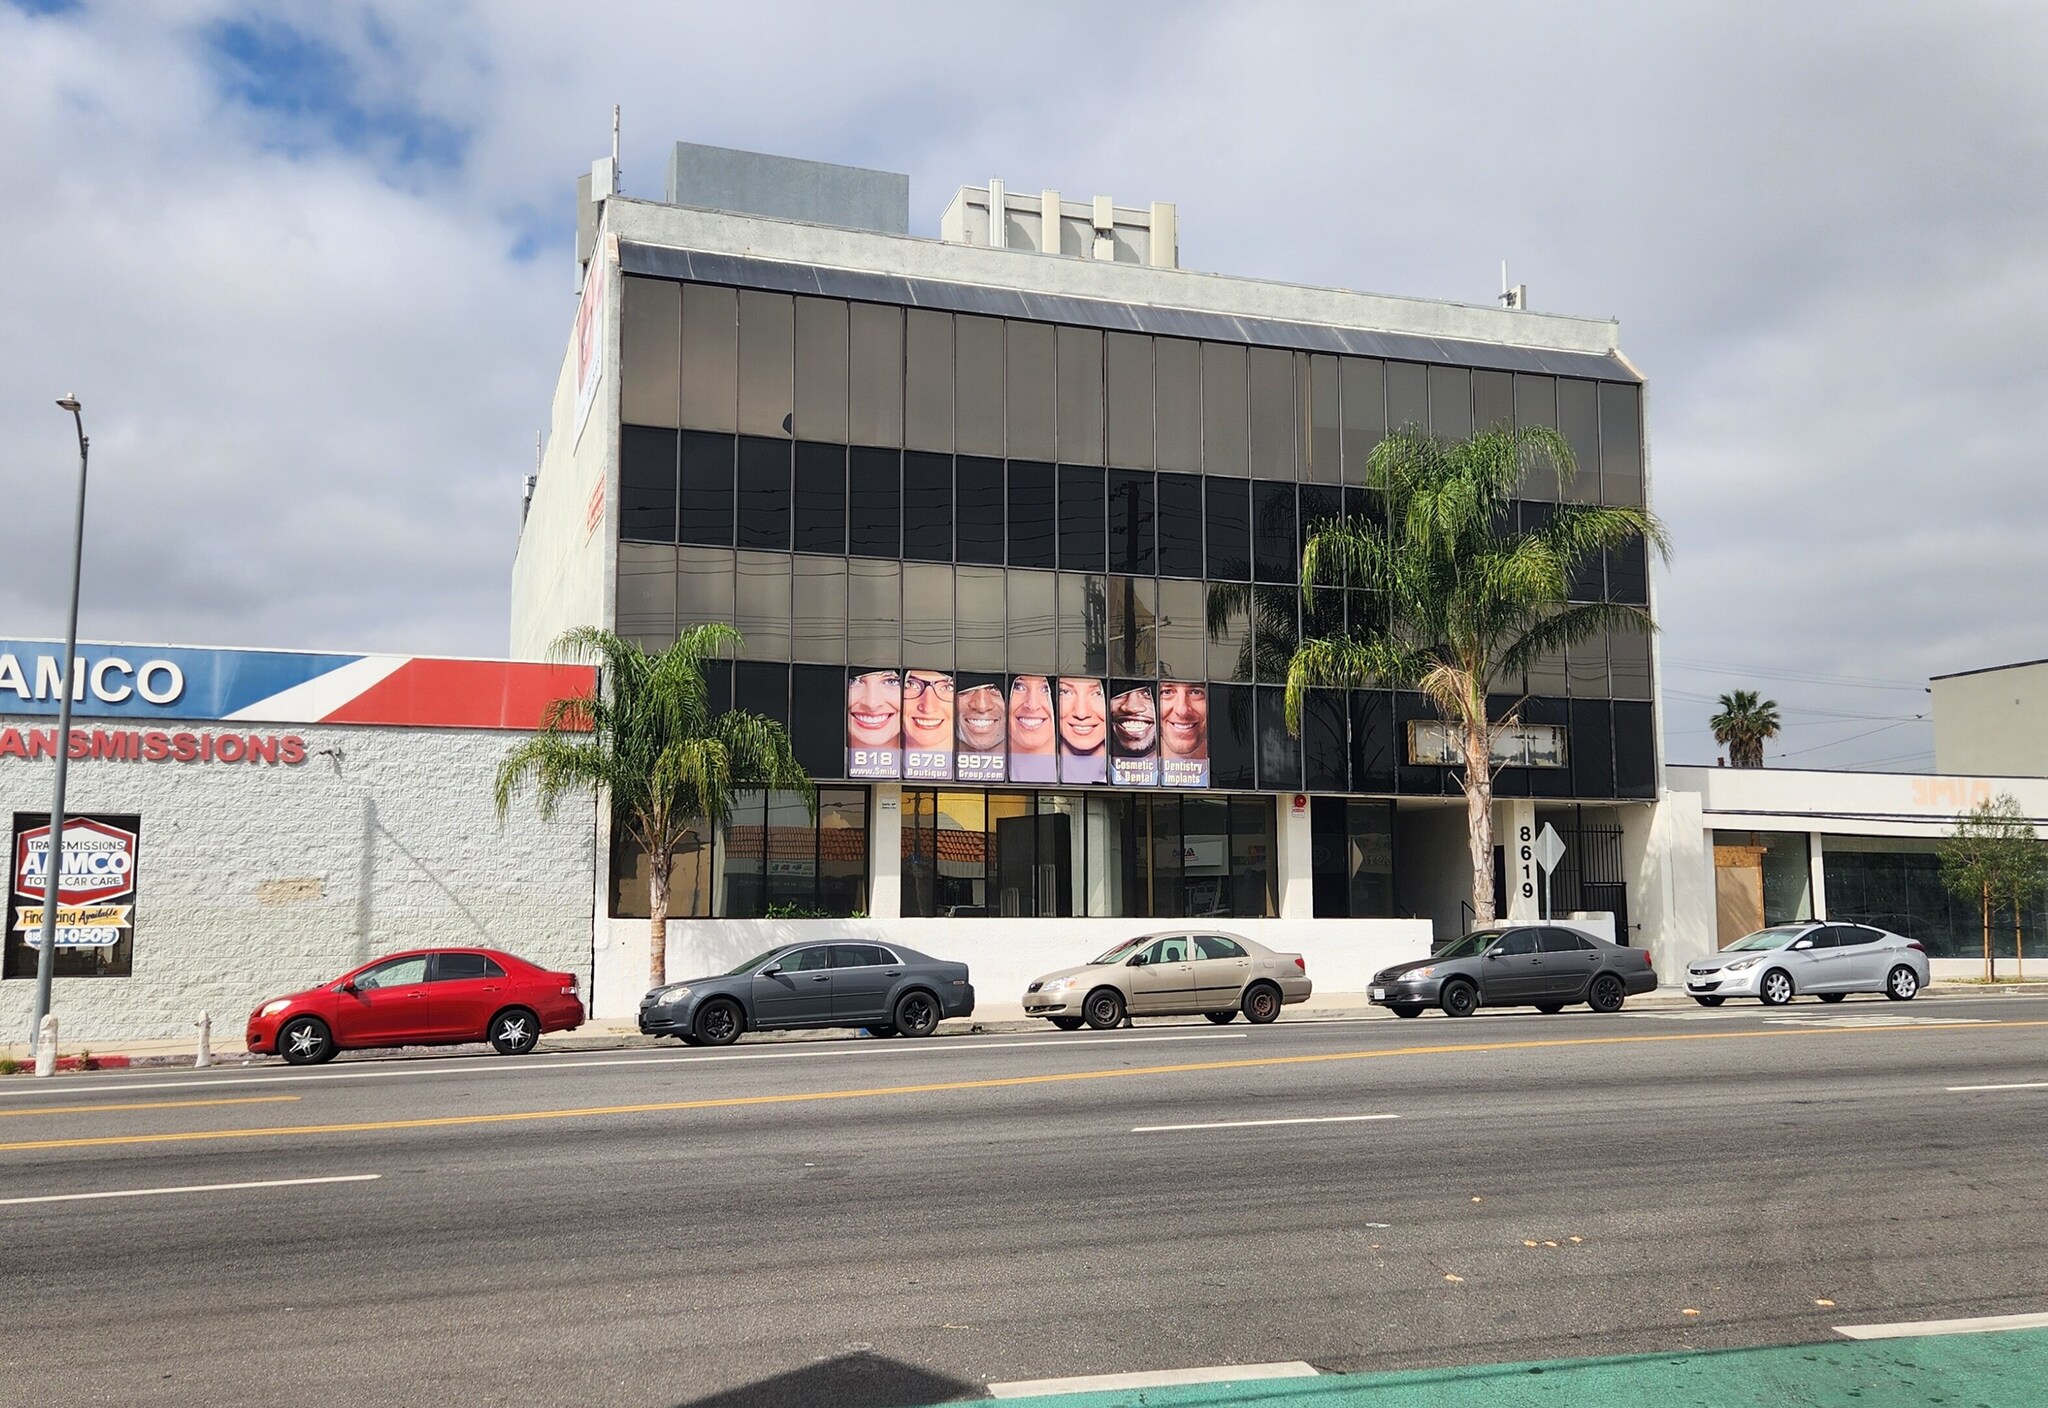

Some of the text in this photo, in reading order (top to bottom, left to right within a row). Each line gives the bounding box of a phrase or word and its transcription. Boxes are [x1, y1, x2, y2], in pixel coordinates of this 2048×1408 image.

[854, 751, 1004, 770] 818 678 9975
[1115, 758, 1203, 774] Cosmetic Dentistry
[850, 767, 1004, 780] www.Smile Boutique Group.com
[1115, 771, 1201, 785] & Dental Implants
[30, 840, 125, 850] TRASMISSIONS
[1520, 826, 1533, 898] 8619
[28, 876, 121, 886] TOTL CAR CARE
[23, 908, 118, 926] Finaing Available
